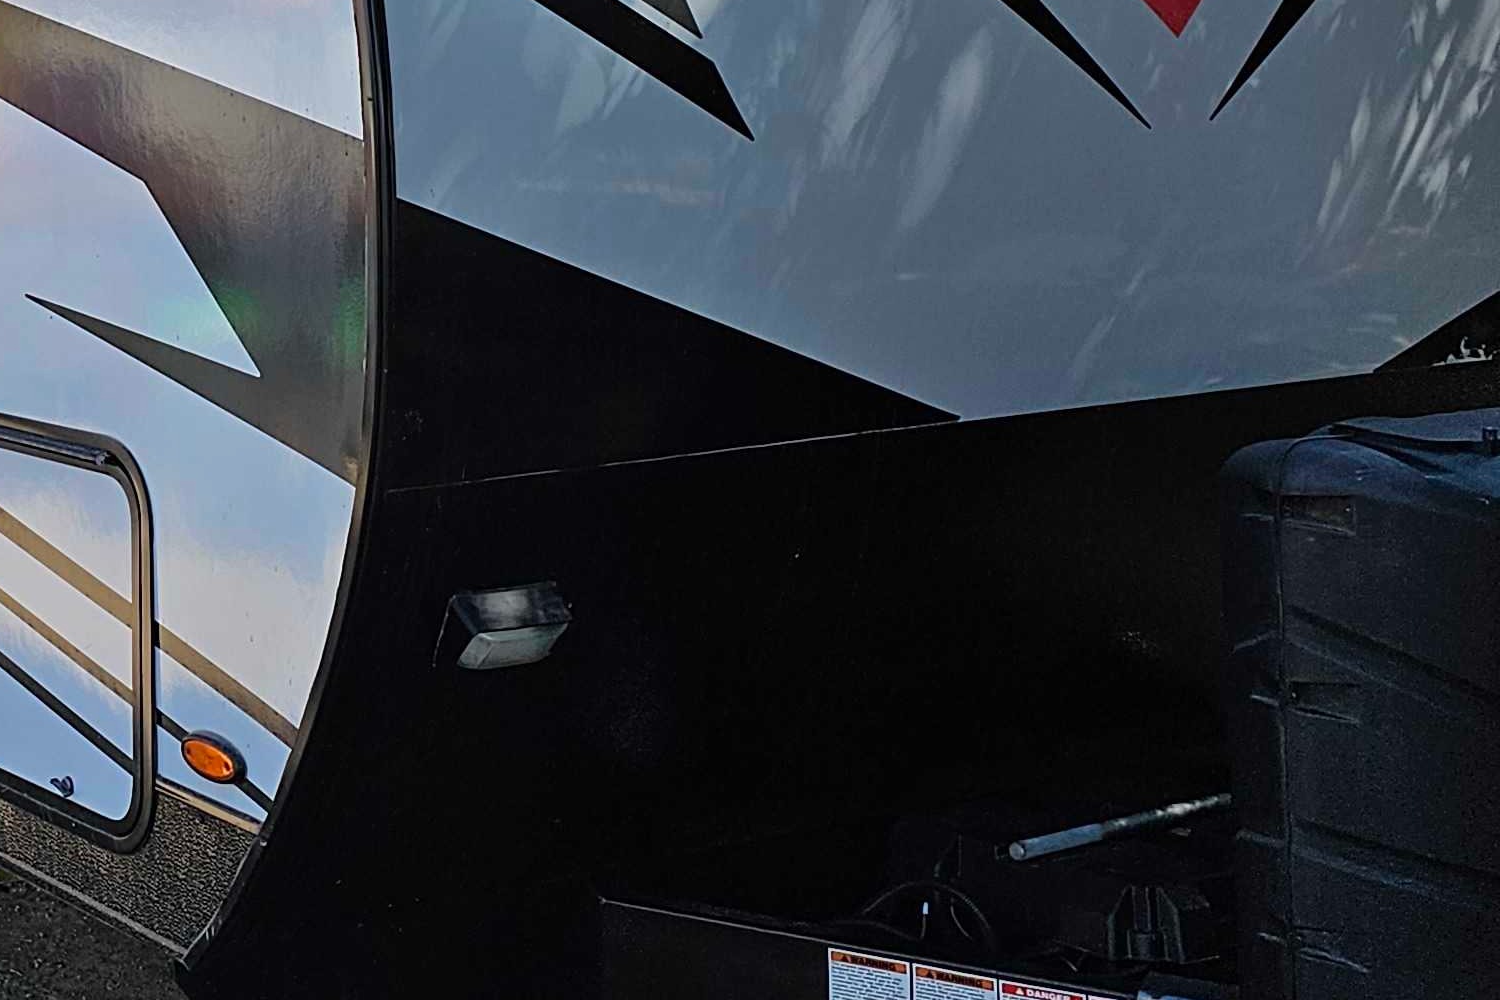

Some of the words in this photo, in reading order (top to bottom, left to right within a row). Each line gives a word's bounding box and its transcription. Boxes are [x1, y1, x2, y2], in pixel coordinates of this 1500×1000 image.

[852, 955, 895, 972] WARNING
[938, 971, 982, 988] WARNING
[1025, 988, 1071, 1000] DANGER
